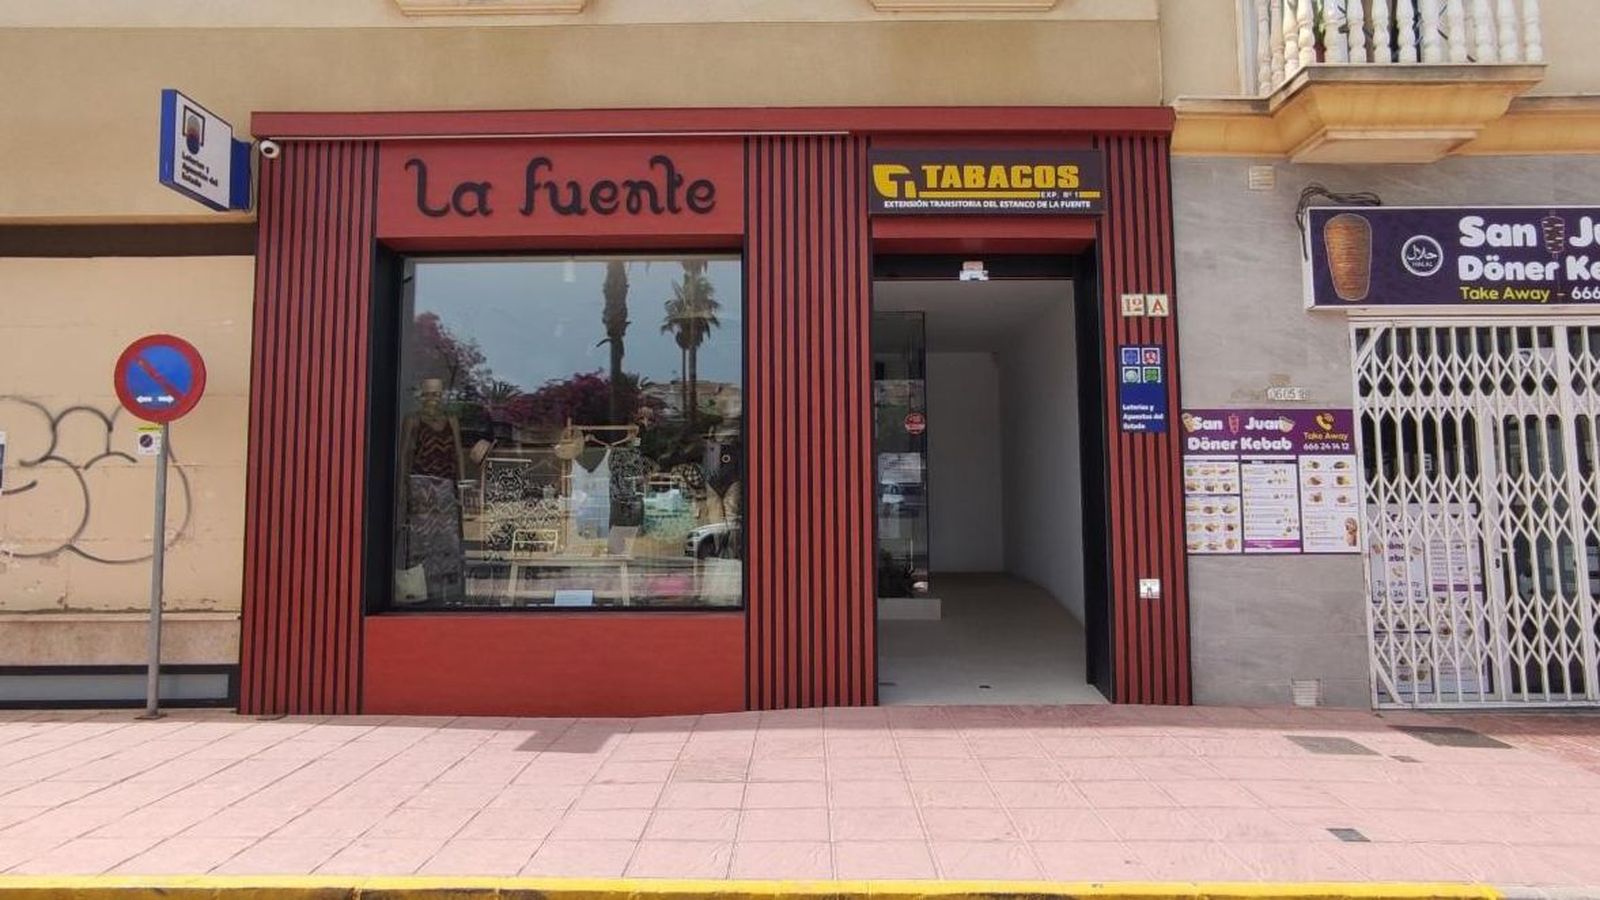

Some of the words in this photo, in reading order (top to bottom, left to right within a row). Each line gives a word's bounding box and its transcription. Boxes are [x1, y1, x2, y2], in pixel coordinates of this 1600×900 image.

[921, 164, 1080, 189] TABACOS
[404, 157, 494, 217] La
[519, 155, 717, 217] fuente
[883, 199, 929, 208] EXTENSIÓN
[930, 200, 981, 208] TRANSITORIA
[983, 200, 998, 208] DEL
[999, 200, 1035, 208] ESTANCO
[1037, 200, 1047, 208] DE
[1048, 200, 1059, 208] LA
[1061, 200, 1091, 208] FUENTE
[1458, 216, 1537, 248] San
[1457, 255, 1561, 281] Döner
[1459, 287, 1500, 301] Take
[1503, 287, 1550, 303] Away
[1571, 286, 1600, 300] 666
[1151, 298, 1166, 313] A
[1193, 416, 1223, 431] San
[1187, 436, 1239, 451] Döner
[1240, 436, 1293, 451] Kebab
[1303, 431, 1323, 440] Take
[1324, 432, 1348, 441] Away
